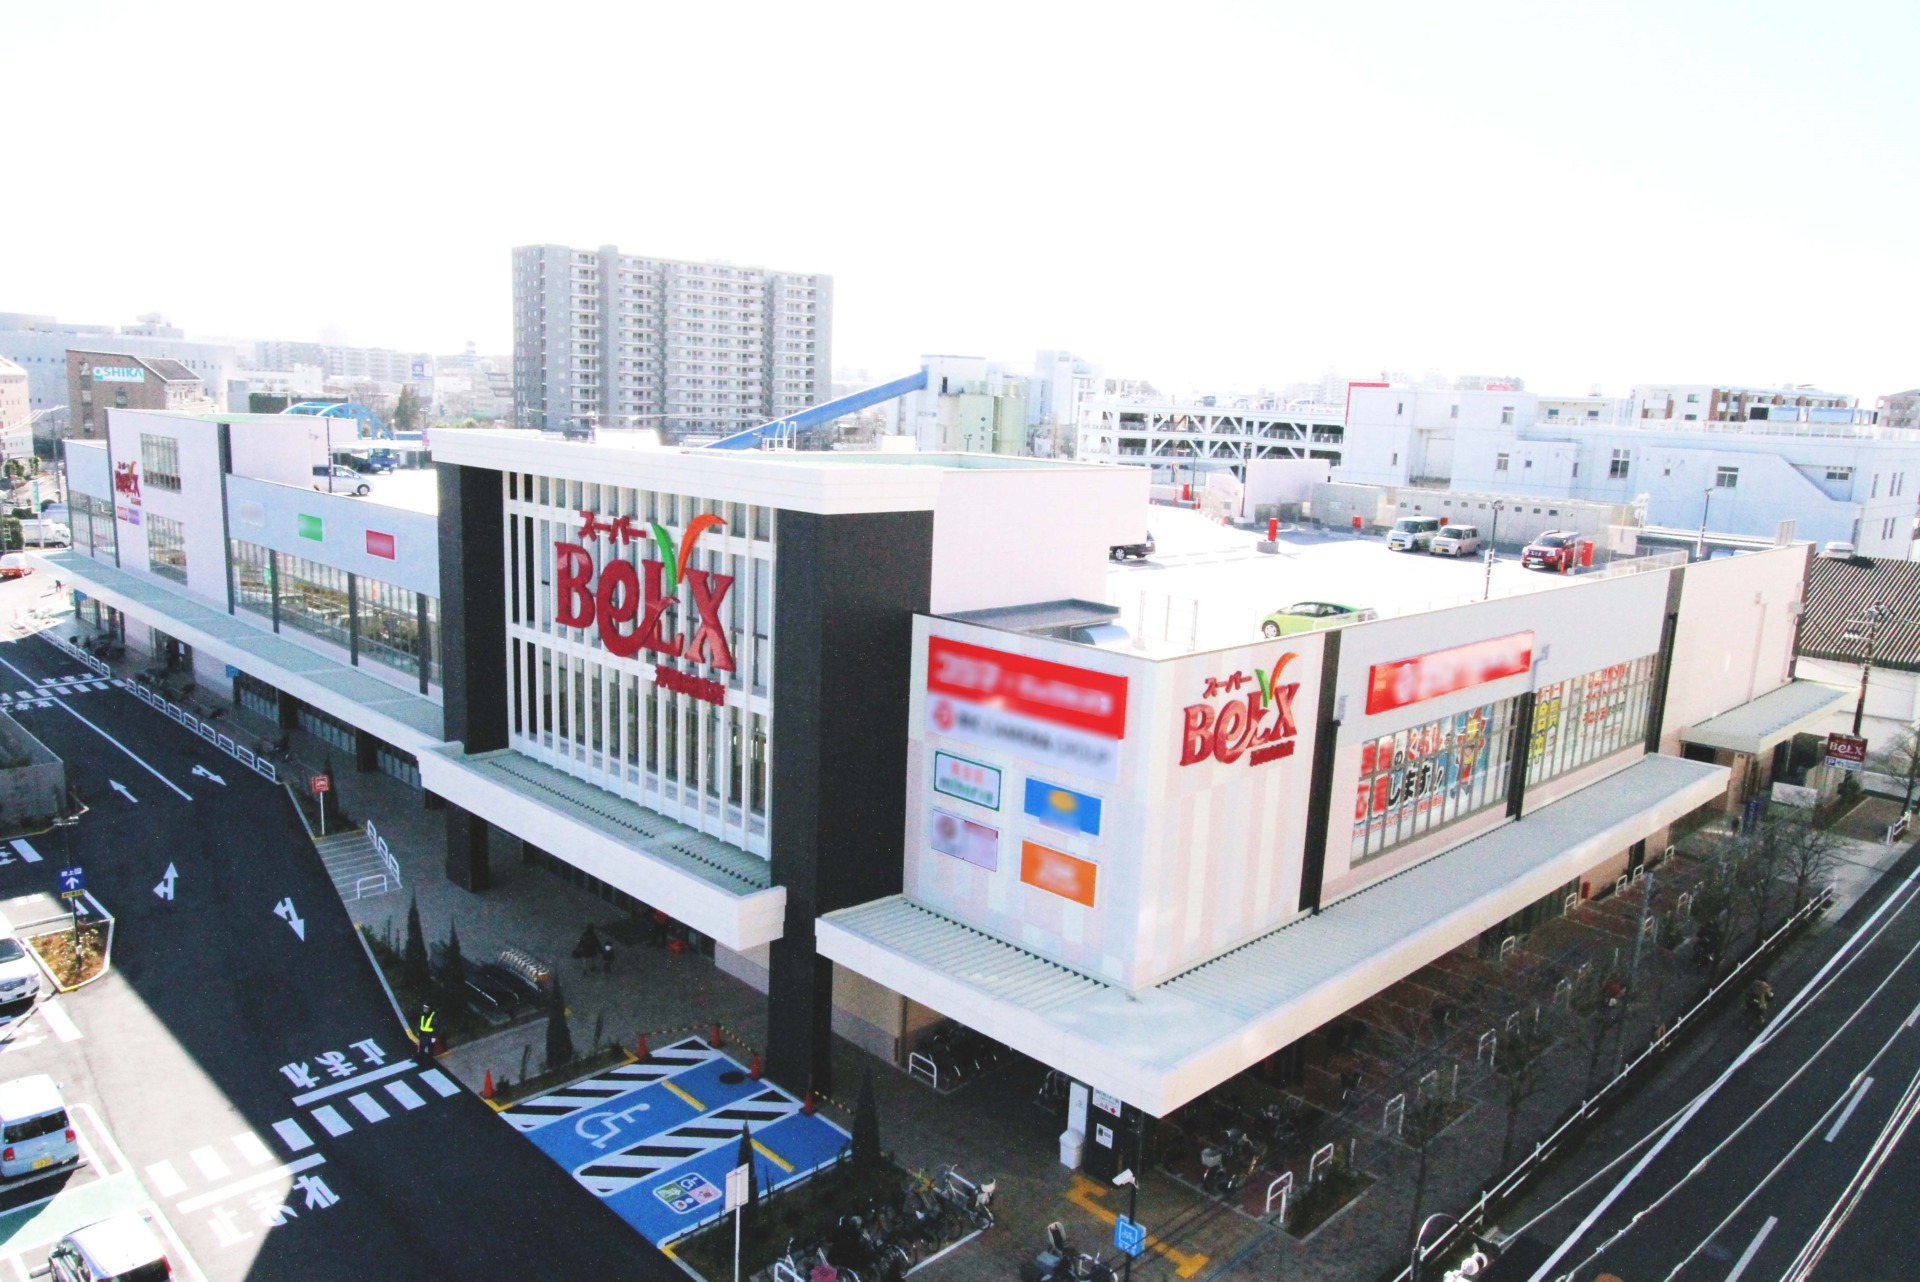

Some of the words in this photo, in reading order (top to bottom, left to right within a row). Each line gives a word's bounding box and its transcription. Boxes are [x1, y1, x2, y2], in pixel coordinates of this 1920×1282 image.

[578, 511, 647, 545] スーパー
[1203, 670, 1252, 699] スーパー
[279, 1038, 386, 1089] 止まれ
[207, 1174, 341, 1248] 止まれ
